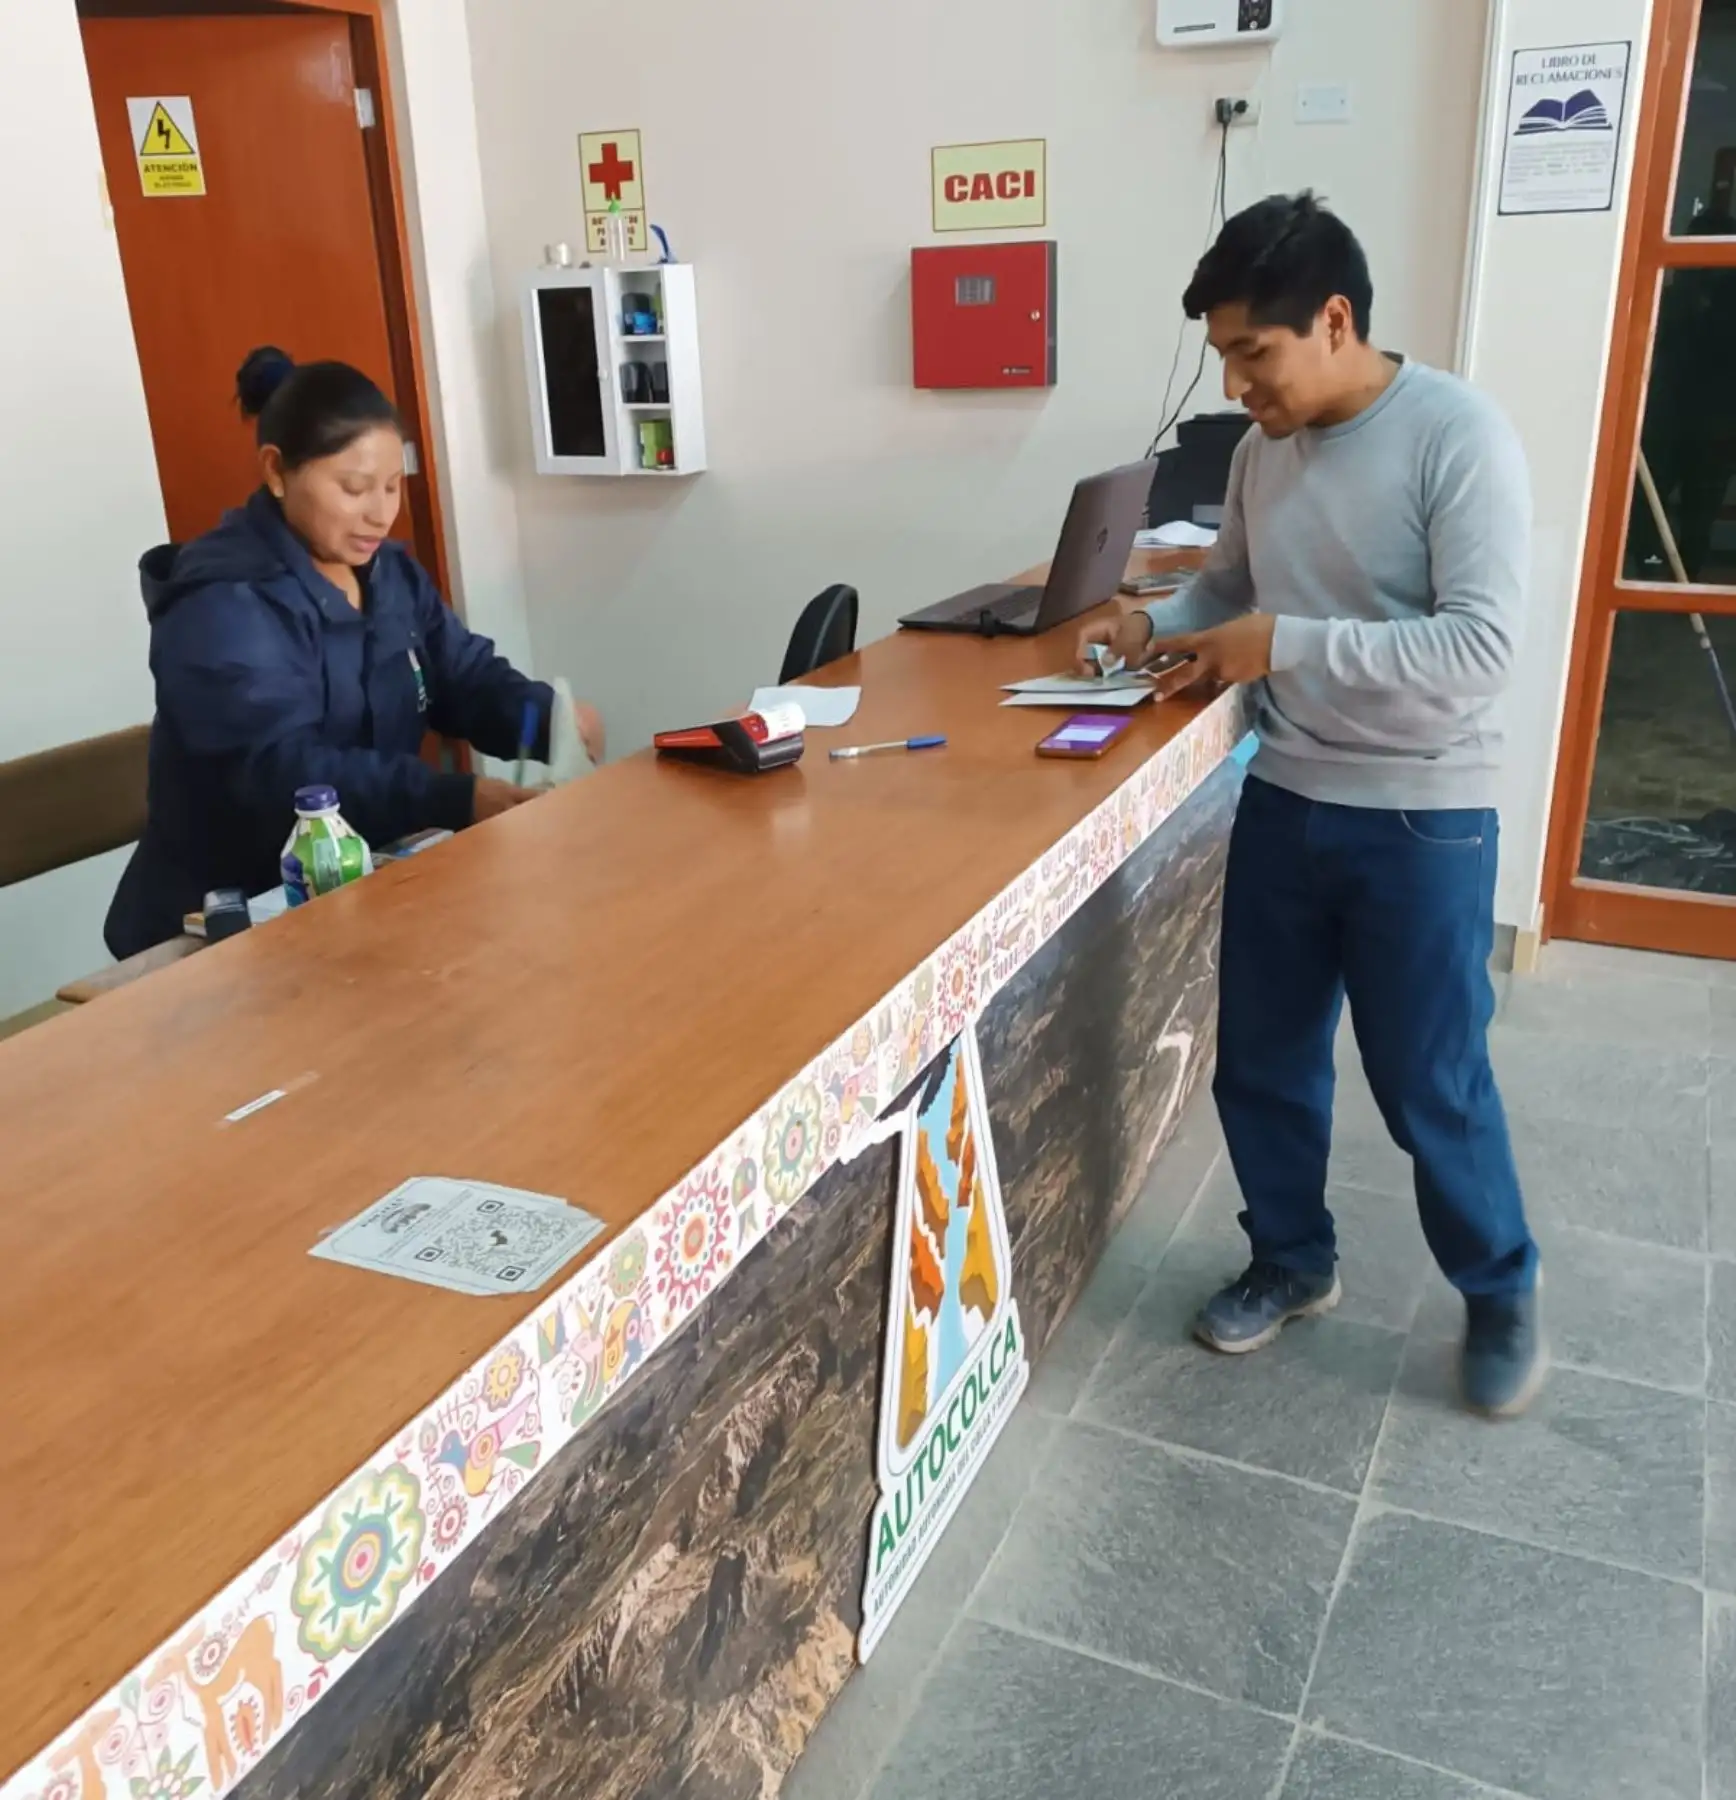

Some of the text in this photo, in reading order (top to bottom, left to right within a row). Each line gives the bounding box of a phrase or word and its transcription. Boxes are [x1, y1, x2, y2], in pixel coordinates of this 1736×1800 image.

[1541, 54, 1579, 69] LIBRO
[1515, 67, 1623, 85] RECLAMACIONES
[944, 169, 1035, 203] CACI
[876, 1315, 1017, 1575] AUTOCOLCA
